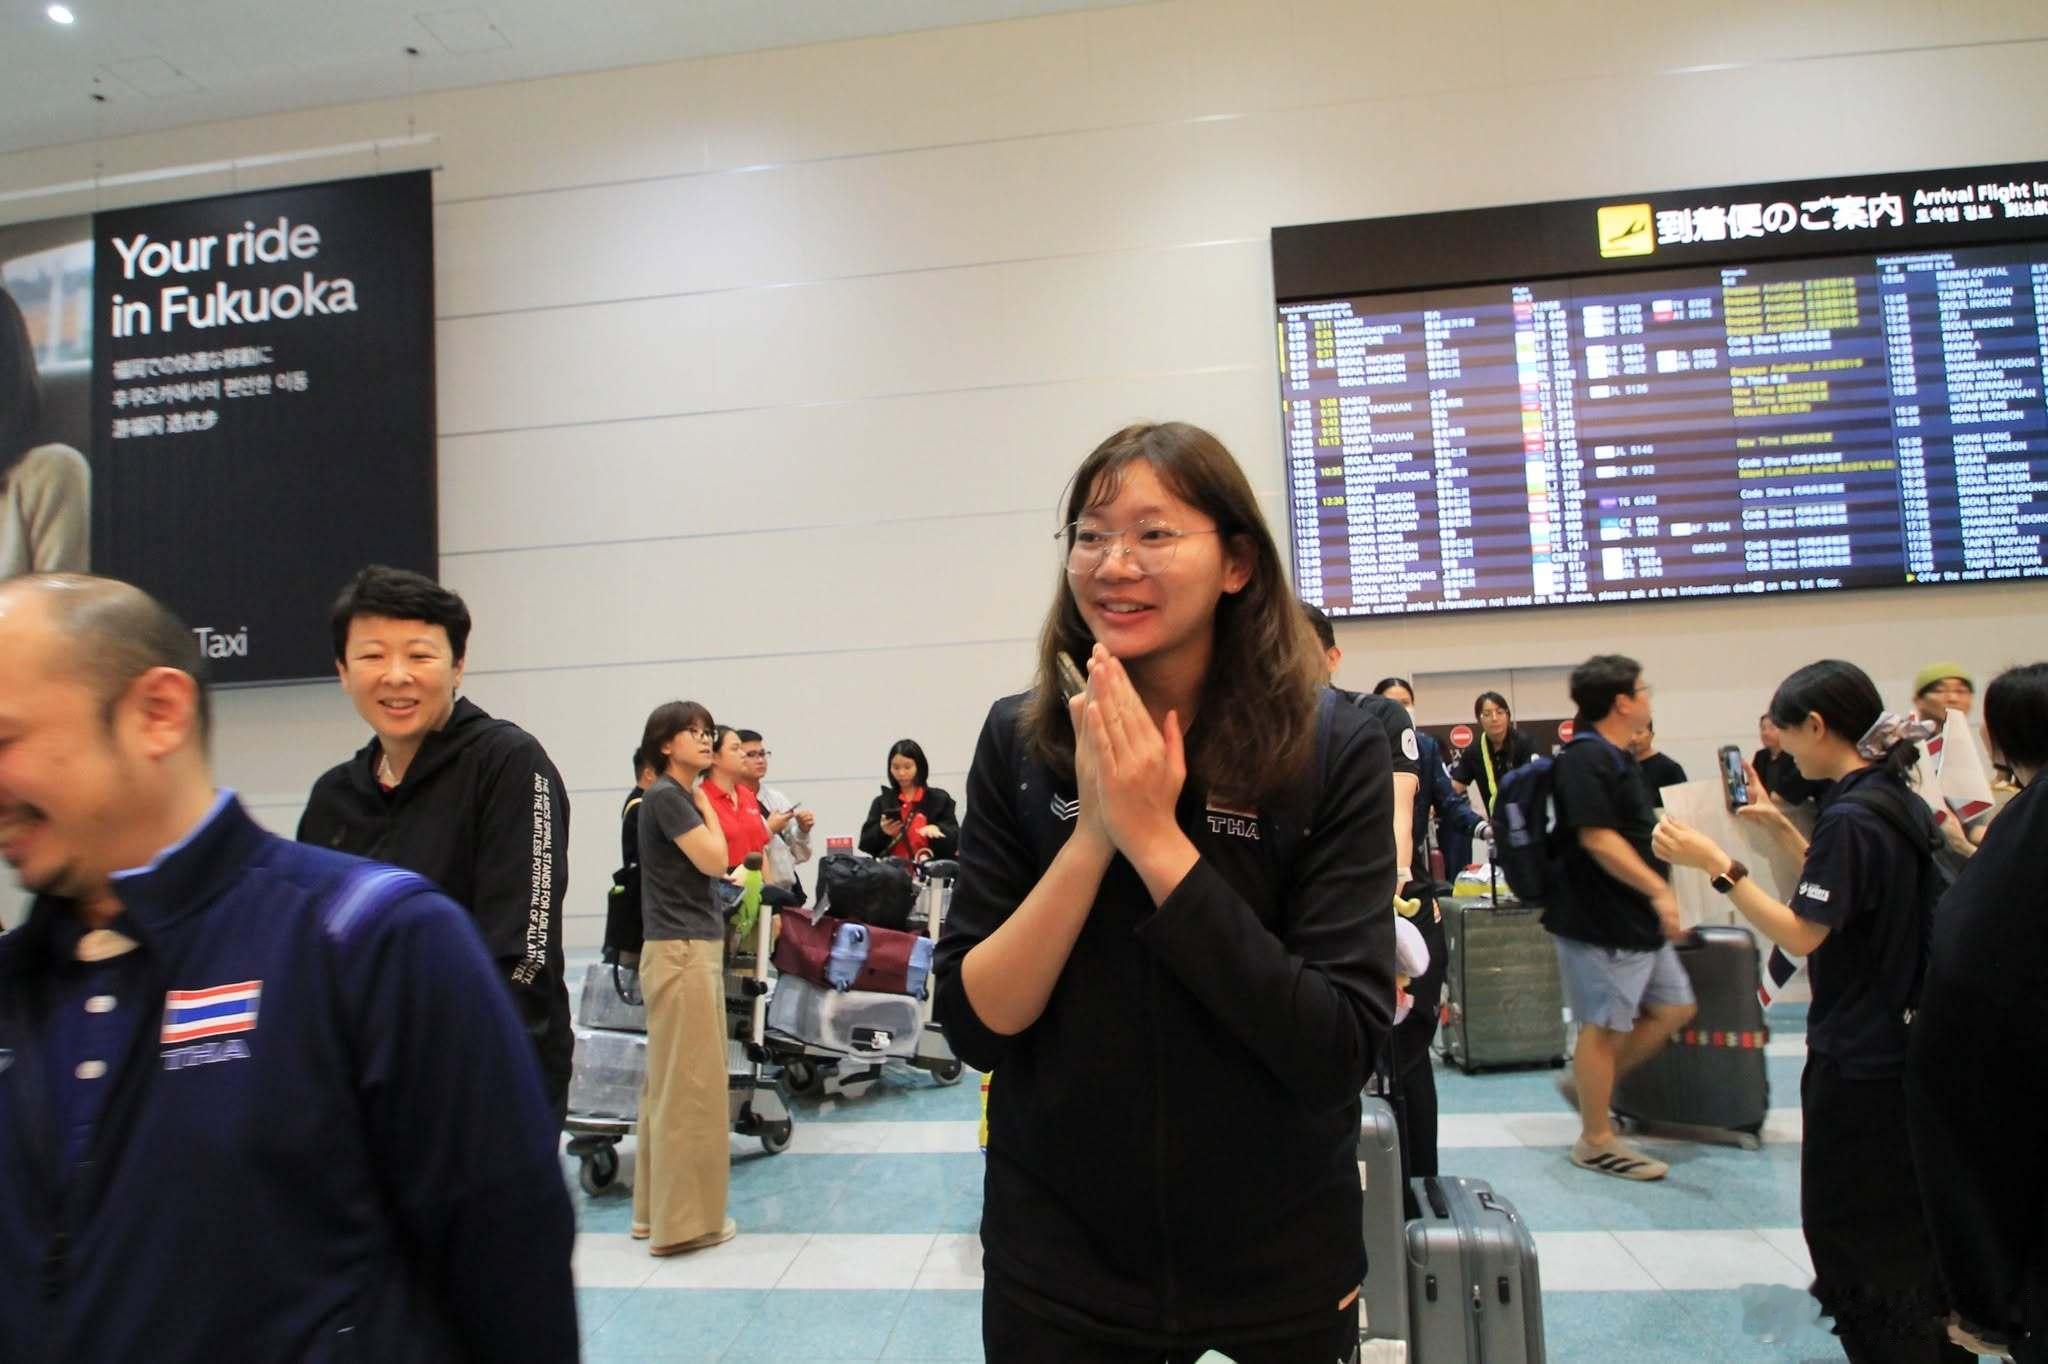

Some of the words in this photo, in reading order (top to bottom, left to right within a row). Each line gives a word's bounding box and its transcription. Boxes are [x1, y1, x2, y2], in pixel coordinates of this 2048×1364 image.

[1913, 185, 1974, 206] Arrival
[1978, 182, 2030, 204] Flight
[1657, 192, 1903, 245] 到着便のご案内
[112, 234, 218, 280] Your
[226, 216, 321, 267] ride
[1971, 267, 2008, 278] CAPITAL
[1967, 287, 2013, 298] TAOYUAN
[112, 294, 151, 338] in
[161, 272, 358, 333] Fukuoka
[1969, 297, 2011, 309] INCHEON
[1971, 317, 2014, 329] INCHEON
[1995, 357, 2036, 369] PUDONG
[1990, 388, 2036, 400] TAOYUAN
[1993, 535, 2040, 546] TAOYUAN
[1995, 556, 2042, 567] TAOYUAN
[192, 626, 248, 658] Taxi
[534, 772, 542, 792] AND
[534, 794, 543, 811] THE
[532, 811, 544, 857] LIMITLESS
[543, 820, 552, 851] SPIRAL
[1207, 815, 1260, 840] THA
[541, 852, 552, 889] STANDS
[531, 857, 541, 907] POTENTIAL
[540, 890, 551, 910] FOR
[529, 909, 539, 923] OF
[526, 923, 537, 941] ALL
